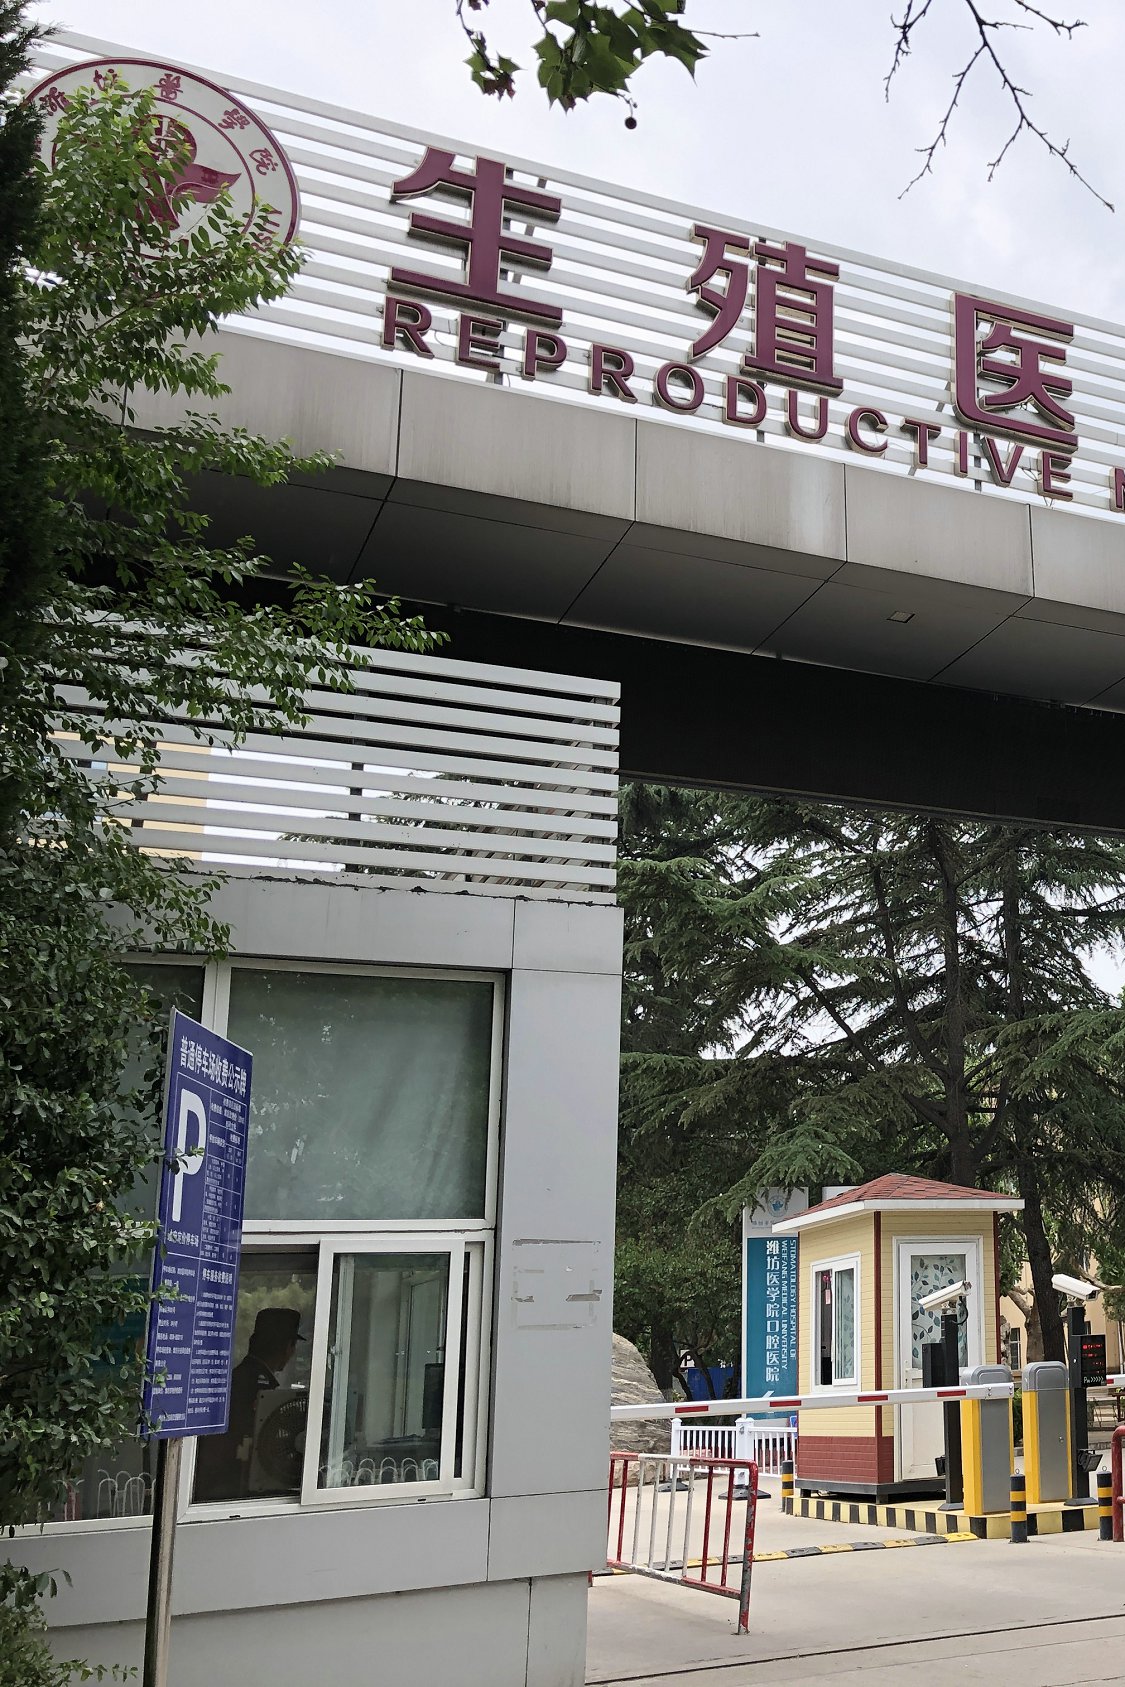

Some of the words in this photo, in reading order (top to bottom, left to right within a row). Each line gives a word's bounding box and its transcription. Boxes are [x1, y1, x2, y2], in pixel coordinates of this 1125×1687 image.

[380, 296, 1074, 500] REPRODUCTIVE
[180, 1036, 247, 1098] 普通停车场收费公示牌
[172, 1088, 206, 1222] P
[766, 1240, 780, 1382] 潍坊医学院口腔医院
